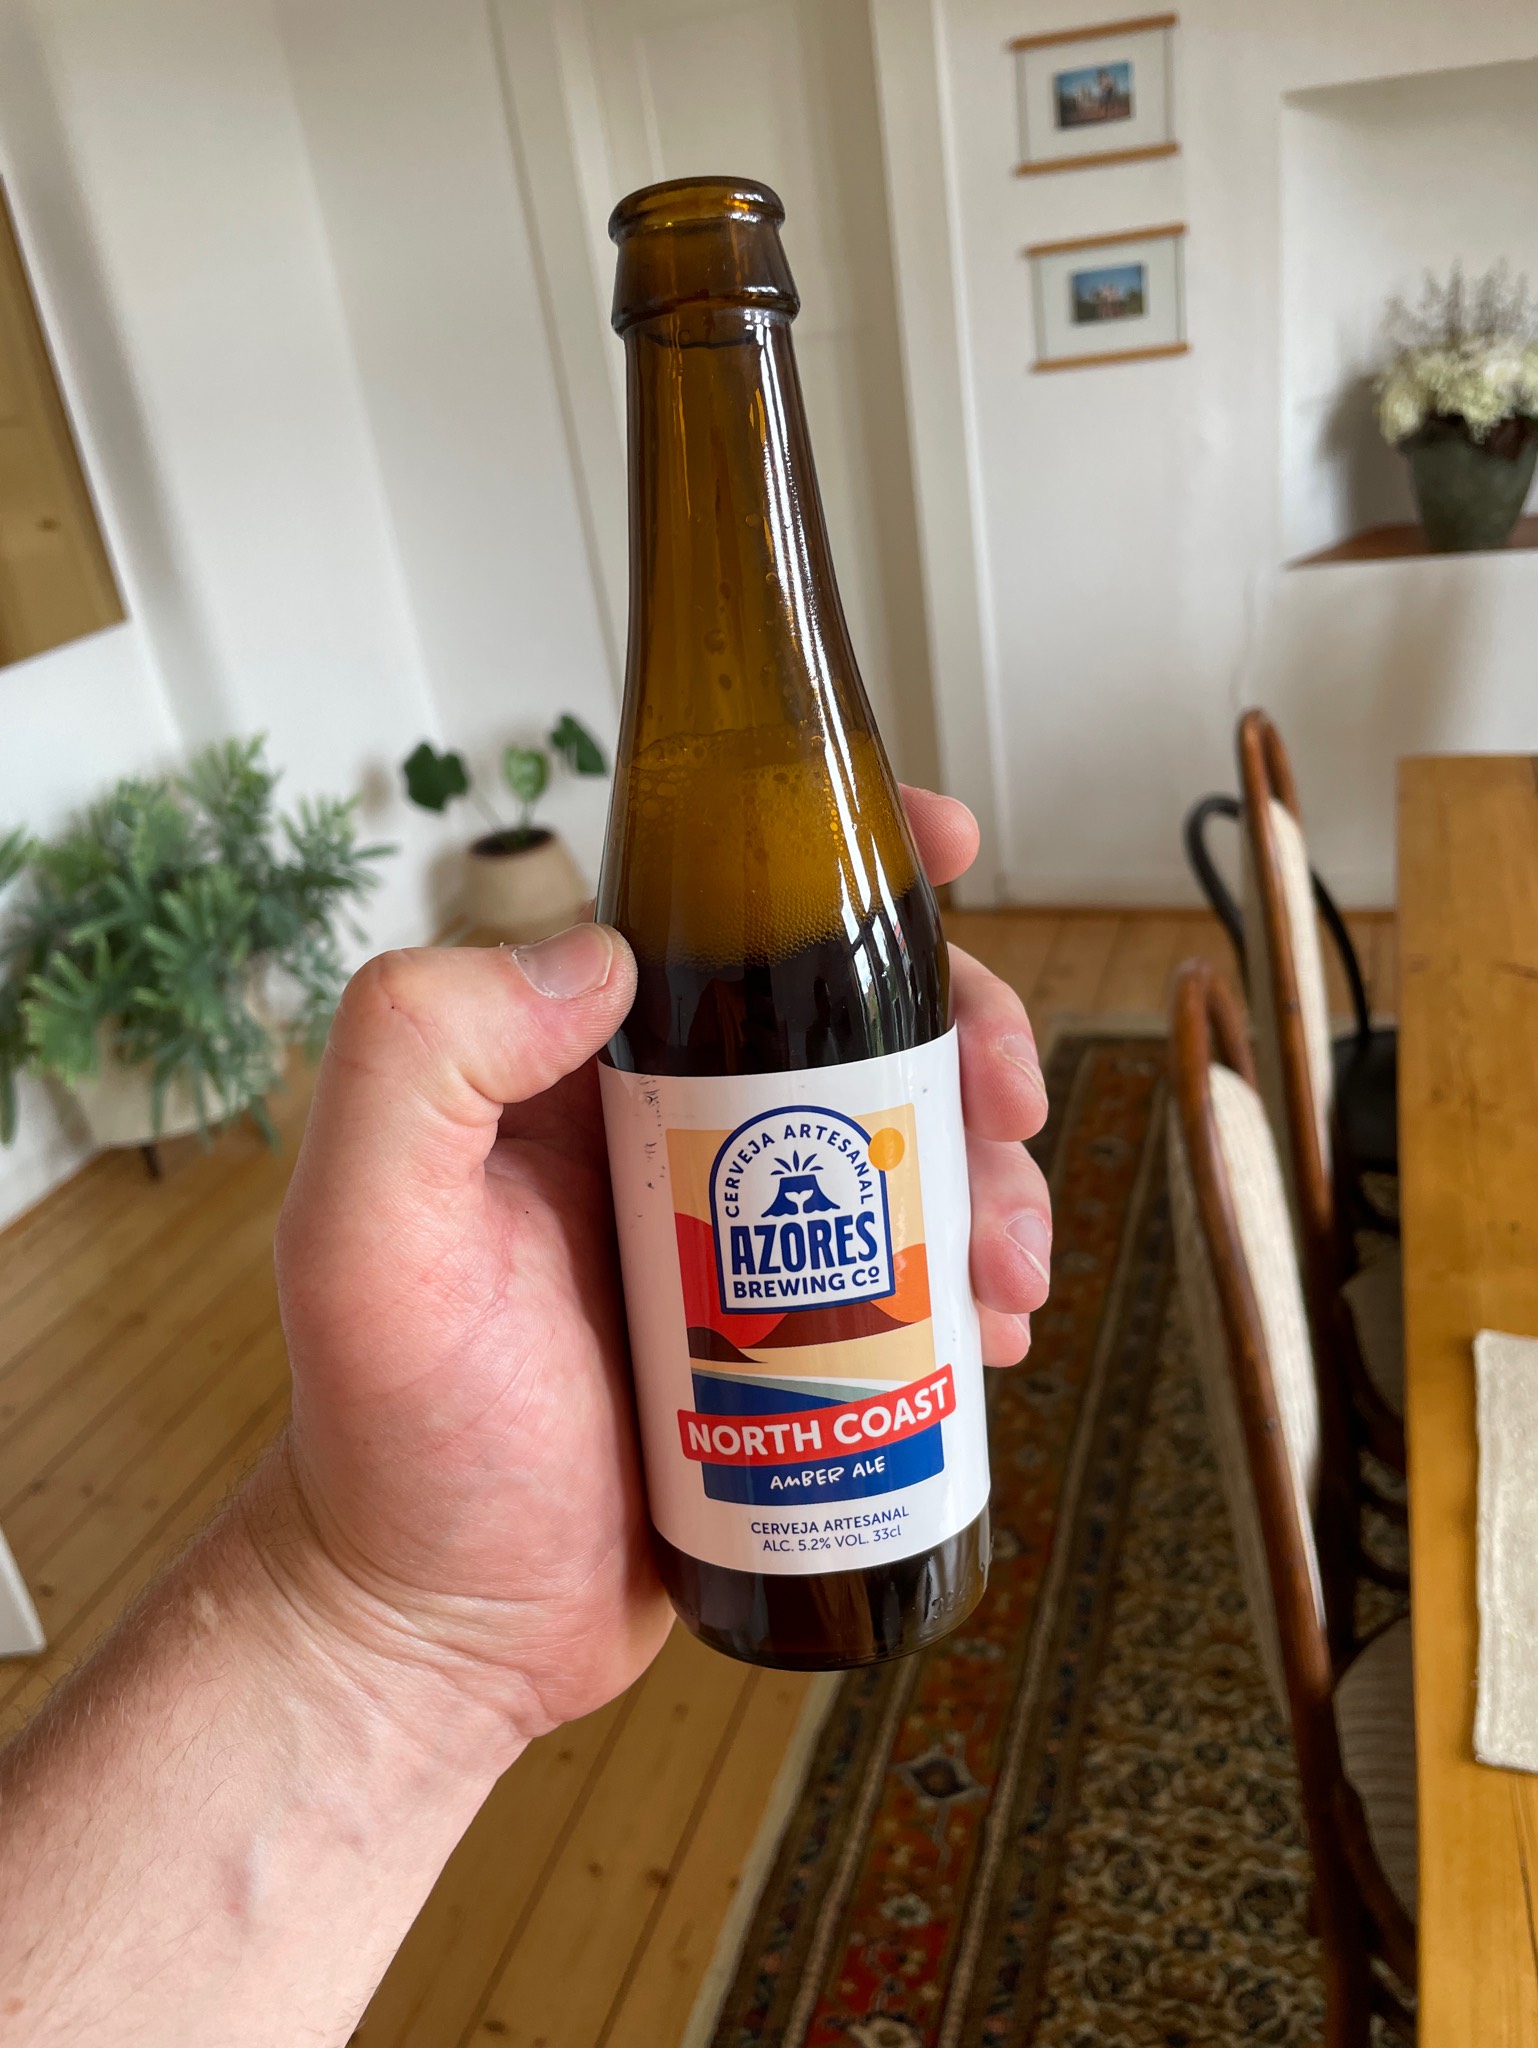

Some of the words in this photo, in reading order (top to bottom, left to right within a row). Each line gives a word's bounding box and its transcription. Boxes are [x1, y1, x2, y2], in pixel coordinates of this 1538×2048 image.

[724, 1132, 775, 1218] CERVEJA
[783, 1123, 874, 1204] ARTESANAL
[730, 1211, 878, 1276] AZORES
[733, 1273, 846, 1299] BREWING
[688, 1420, 823, 1456] NORTH
[833, 1376, 948, 1444] COAST
[770, 1466, 845, 1490] AMBER
[852, 1455, 886, 1478] ALE
[751, 1520, 819, 1535] CERVEJA
[823, 1505, 910, 1533] ARTESANAL
[763, 1538, 794, 1552] ALC.
[798, 1533, 831, 1551] 5.2%
[834, 1533, 869, 1547] VOL.
[873, 1525, 902, 1542] 33cl
